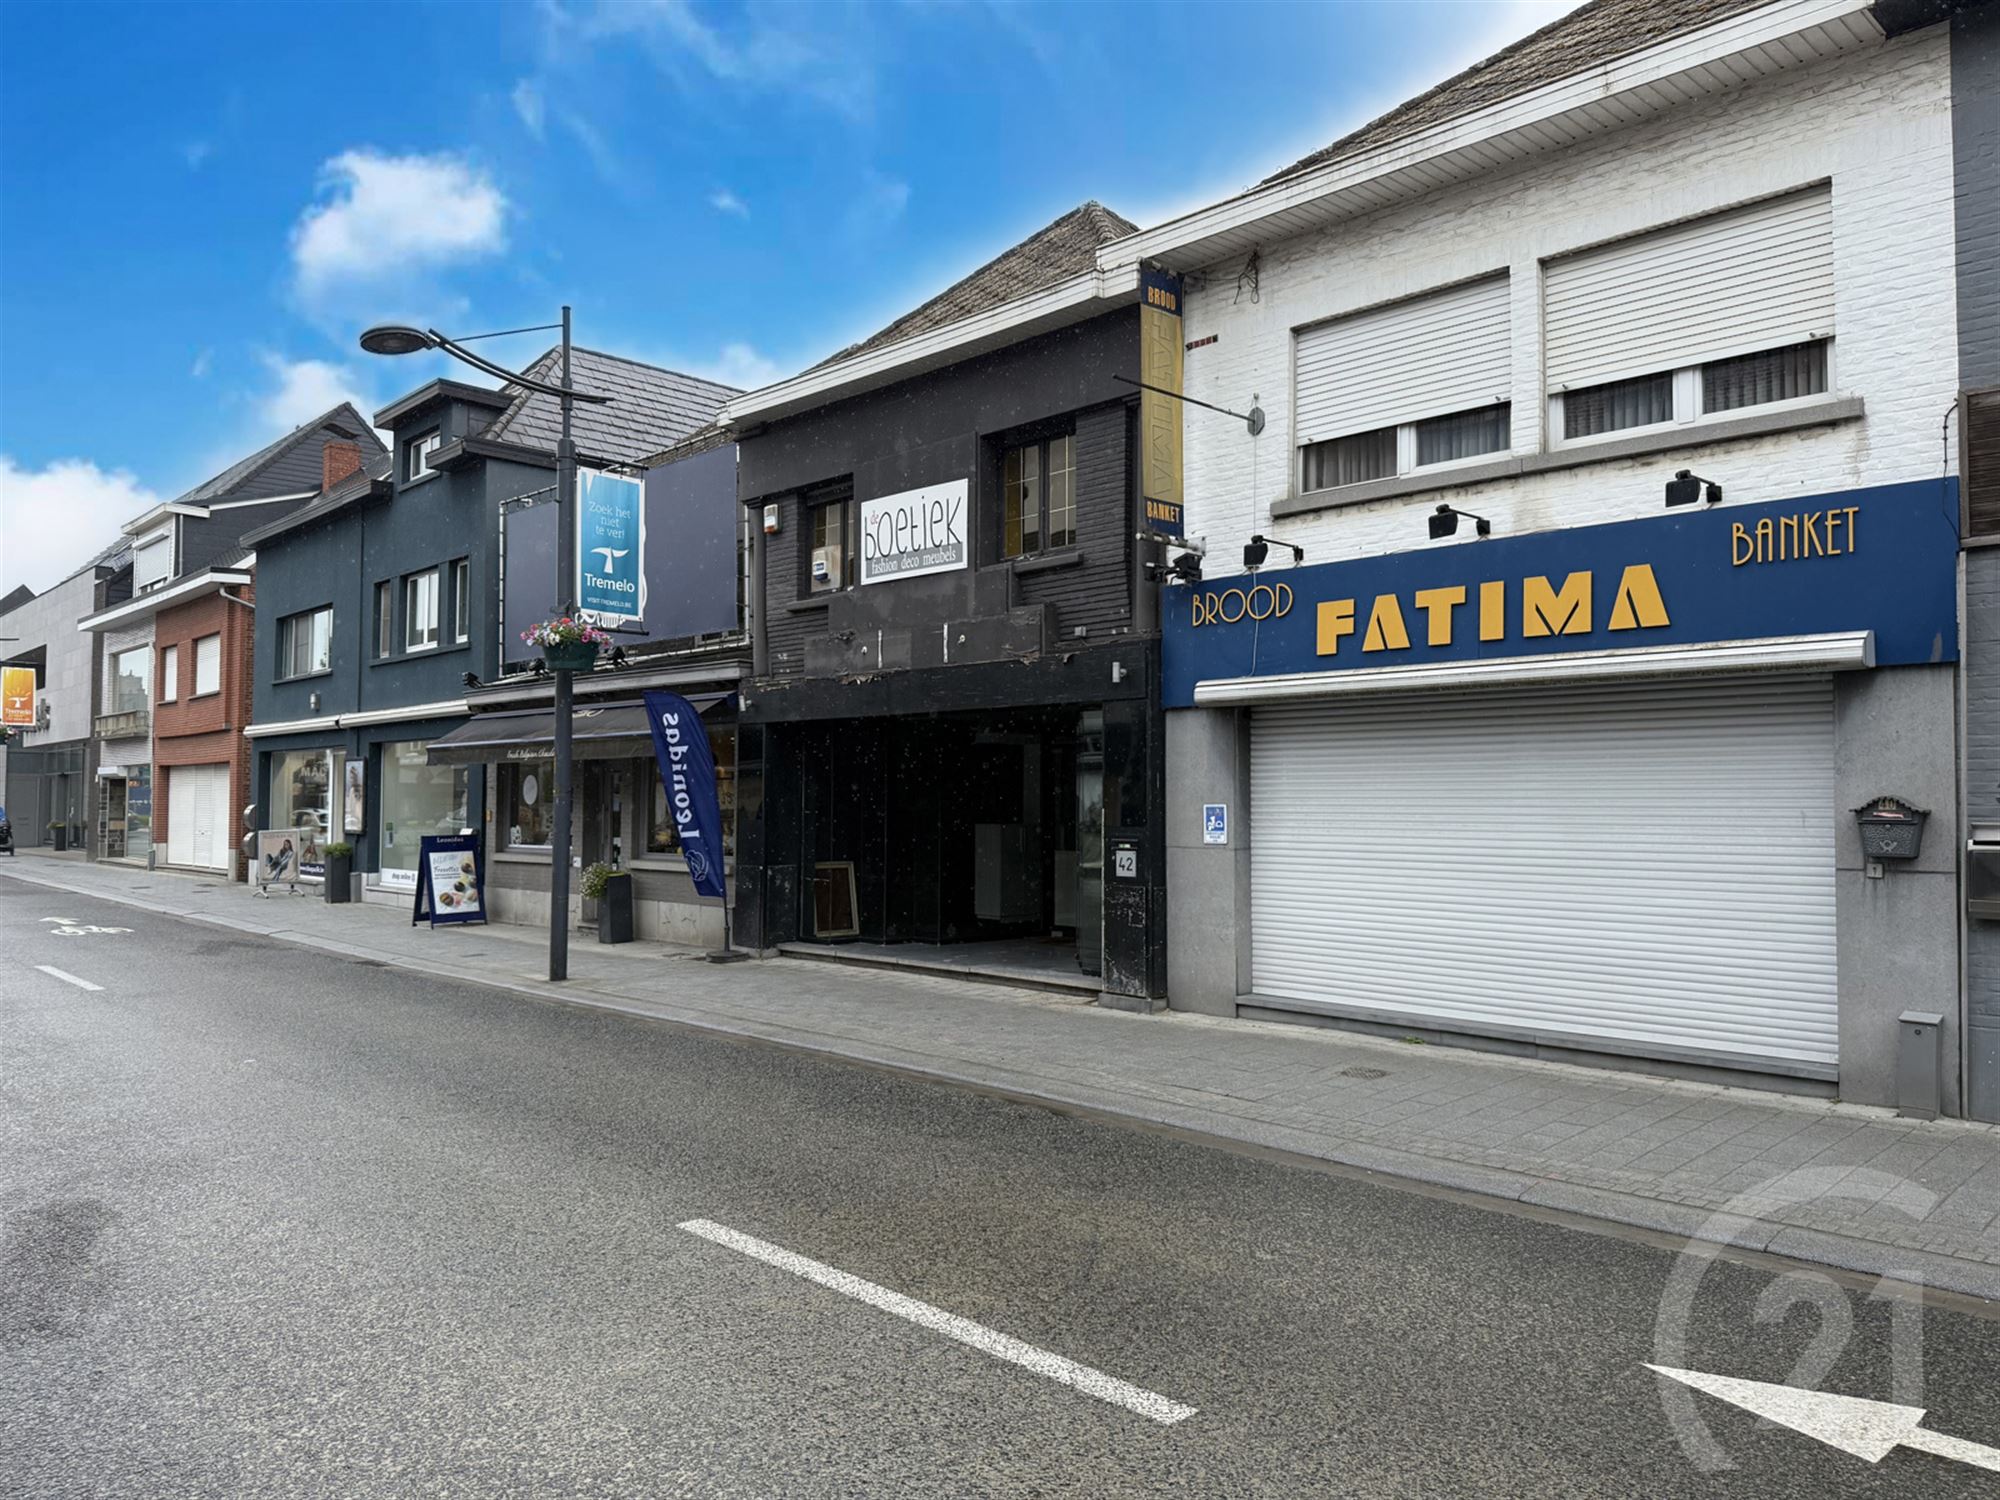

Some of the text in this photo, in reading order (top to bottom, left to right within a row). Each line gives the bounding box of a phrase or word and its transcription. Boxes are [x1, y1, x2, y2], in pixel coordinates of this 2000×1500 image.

[1147, 285, 1177, 312] BROOD
[588, 501, 631, 520] Zoek het
[600, 517, 620, 529] niet
[1146, 499, 1181, 523] BANKET
[595, 525, 605, 536] te
[1732, 505, 1861, 567] BANKET
[871, 546, 957, 575] fashion deco meubels
[585, 572, 636, 594] Tremelo
[1191, 582, 1294, 627] BROOD
[1315, 563, 1672, 657] FATIMA
[662, 712, 701, 839] Leonidas
[1117, 856, 1134, 873] 42
